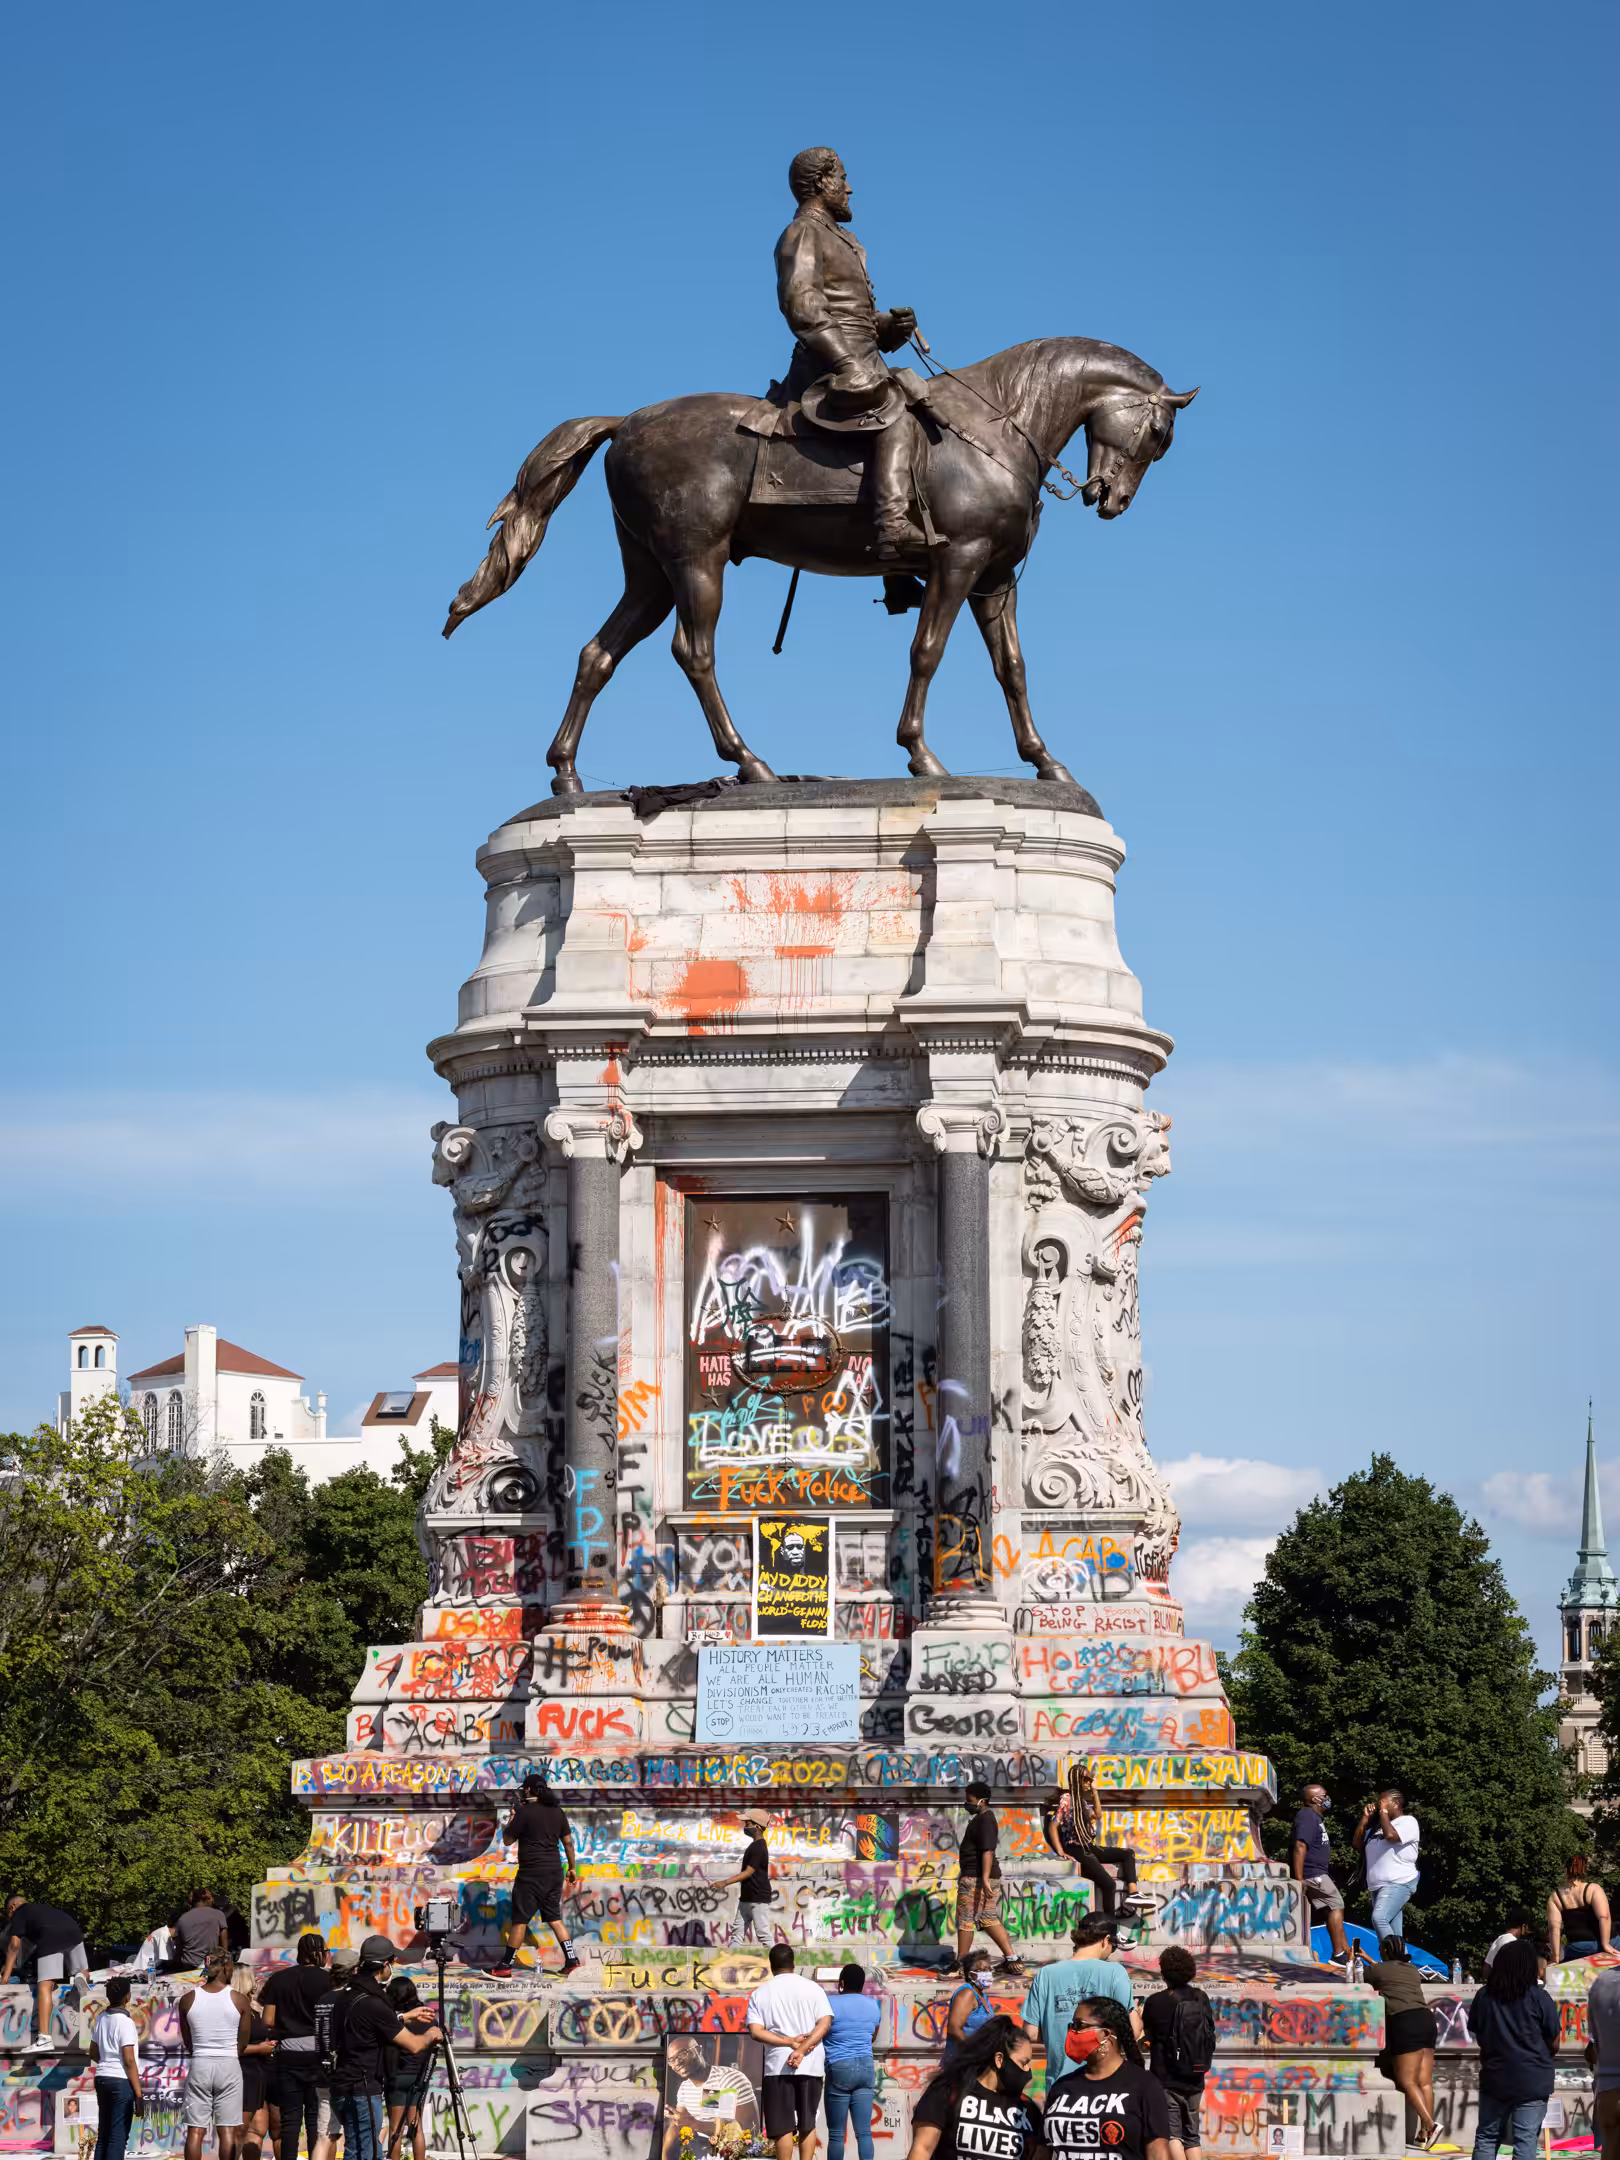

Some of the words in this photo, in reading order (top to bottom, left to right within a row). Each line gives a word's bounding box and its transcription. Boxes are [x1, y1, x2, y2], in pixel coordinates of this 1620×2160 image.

[700, 1356, 732, 1373] HATE
[708, 1372, 732, 1387] HAS
[779, 1574, 828, 1591] DADDY
[758, 1591, 808, 1604] CHANGED
[807, 1591, 828, 1602] THE
[801, 1619, 828, 1629] FLOYD
[1095, 1618, 1147, 1634] RACIST
[709, 1650, 761, 1665] HISTORY
[766, 1649, 823, 1663] MATTERS
[719, 1664, 737, 1674] ALL
[745, 1663, 780, 1672] PEOPLE
[790, 1661, 834, 1671] MATTER
[706, 1676, 721, 1686] WE
[730, 1674, 750, 1685] ARE
[758, 1674, 777, 1684] ALL
[785, 1671, 829, 1686] HUMAN
[707, 1685, 768, 1698] DIVISIONISM
[816, 1684, 854, 1695] RACISM
[707, 1700, 734, 1710] LET'S
[740, 1697, 773, 1706] CHANGE
[537, 1703, 635, 1740] FUCK
[711, 1717, 730, 1727] STOP
[381, 1763, 451, 1786] REASON
[994, 1754, 1048, 1786] ACAB
[1200, 1755, 1267, 1786] STAND
[620, 1810, 686, 1840] BLACK
[1167, 1832, 1257, 1864] BLM
[601, 1918, 655, 1945] BLM
[883, 2116, 901, 2128] BLM
[960, 2095, 1034, 2132] BLACK
[957, 2124, 1023, 2158] LIVES
[1048, 2119, 1099, 2146] IVES
